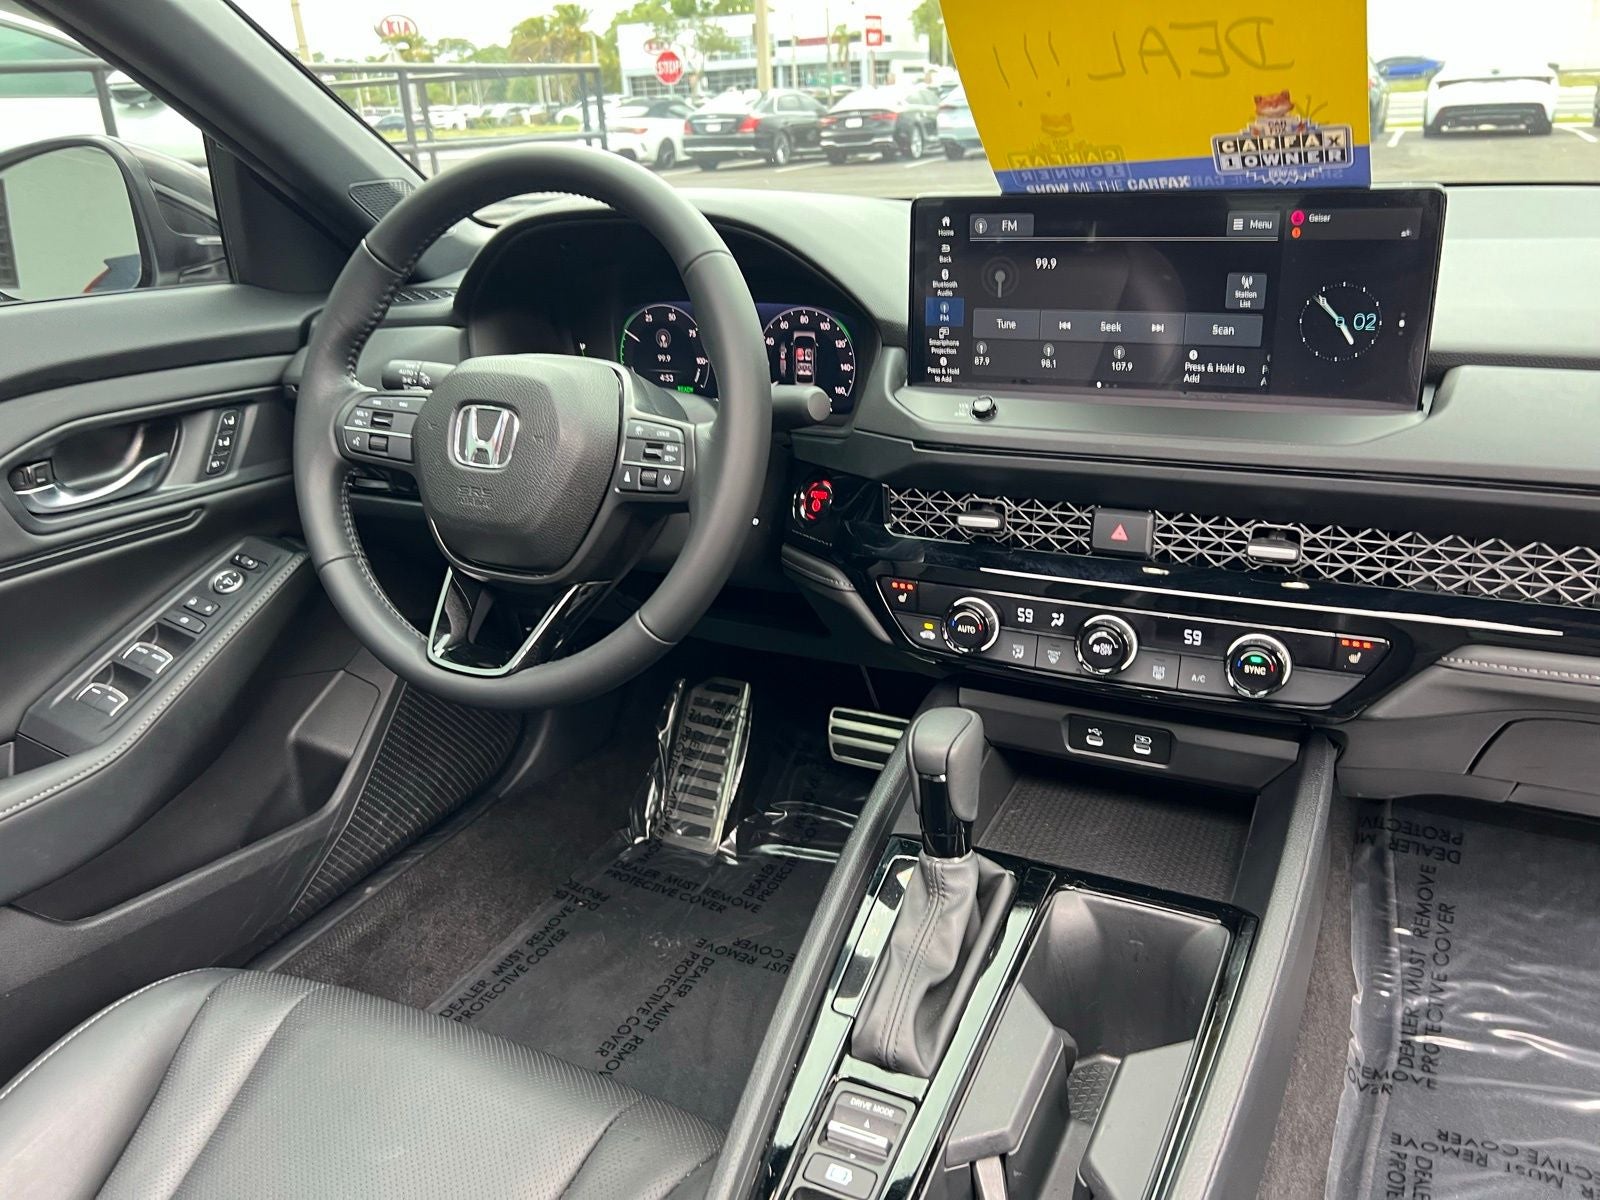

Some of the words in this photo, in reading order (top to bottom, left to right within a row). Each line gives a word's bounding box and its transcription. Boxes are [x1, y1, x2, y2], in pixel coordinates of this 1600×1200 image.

[385, 19, 412, 36] KIA
[658, 60, 680, 75] STOP
[1221, 133, 1342, 154] CARFAX
[1243, 150, 1342, 168] OWNER
[1026, 182, 1070, 194] SHOW
[1073, 181, 1091, 193] ME
[1098, 180, 1125, 192] THE
[1127, 176, 1191, 191] CARFAX
[1002, 220, 1018, 232] FM
[1250, 219, 1273, 230] Menu
[938, 228, 955, 237] Home
[939, 255, 952, 264] Back
[1035, 257, 1057, 270] 99.9
[932, 280, 958, 288] Bluetooth
[937, 288, 953, 297] Audio
[1234, 290, 1257, 299] Station
[1239, 299, 1251, 308] List
[800, 315, 809, 324] 80
[939, 314, 949, 322] FM
[996, 318, 1017, 330] Tune
[1352, 313, 1377, 331] 02
[780, 320, 789, 330] 60
[820, 322, 831, 331] 100
[1100, 321, 1122, 333] Seek
[1212, 324, 1235, 336] Scan
[766, 337, 775, 346] 40
[835, 340, 846, 349] 120
[929, 338, 960, 347] Smartphone
[931, 346, 957, 355] Projection
[657, 353, 671, 363] 99.9
[696, 356, 706, 366] 100
[974, 356, 990, 366] 87.9
[1040, 358, 1057, 369] 98.1
[840, 363, 851, 372] 140
[927, 366, 941, 375] Press
[947, 367, 960, 376] Hold
[1111, 361, 1133, 371] 107.9
[1184, 361, 1206, 373] Press
[1207, 363, 1214, 373] &
[1215, 363, 1235, 374] Hold
[1236, 365, 1246, 374] to
[941, 375, 953, 383] Add
[1183, 374, 1200, 384] Add
[835, 386, 846, 395] 160
[1017, 607, 1034, 623] 59
[957, 624, 976, 635] AUTO
[1183, 629, 1203, 646] 59
[1243, 665, 1267, 676] SYNC
[1191, 674, 1206, 683] A/C
[1360, 815, 1465, 846] PROTECTIV
[602, 868, 680, 898] PROTECTIVE
[679, 892, 729, 914] COVER
[613, 860, 661, 879] DEALER
[663, 875, 700, 892] MUST
[701, 887, 763, 915] REMOVE
[1411, 863, 1438, 940] REMOVE
[1431, 901, 1457, 967] COVER
[694, 937, 759, 967] REMOVE
[731, 936, 785, 960] COVER
[438, 978, 492, 1019] DEALER
[491, 948, 526, 977] MUST
[525, 904, 577, 948] REMOVE
[762, 959, 791, 976] UST
[452, 962, 530, 1024] PROTECTIVE
[526, 928, 571, 966] COVER
[677, 956, 716, 999] DEALER
[1404, 948, 1427, 997] MUST
[636, 950, 701, 1016] PROTECTIVE
[642, 1001, 676, 1033] MUST
[1420, 970, 1449, 1076] PROECTIVE
[594, 1015, 640, 1058] COVER
[598, 1034, 645, 1077] REMOV
[850, 1096, 871, 1111] DRIVE
[872, 1103, 896, 1119] MODE
[1436, 1128, 1520, 1158] COVER
[1390, 1131, 1489, 1168] REMOVE
[1504, 1160, 1565, 1190] MUST
